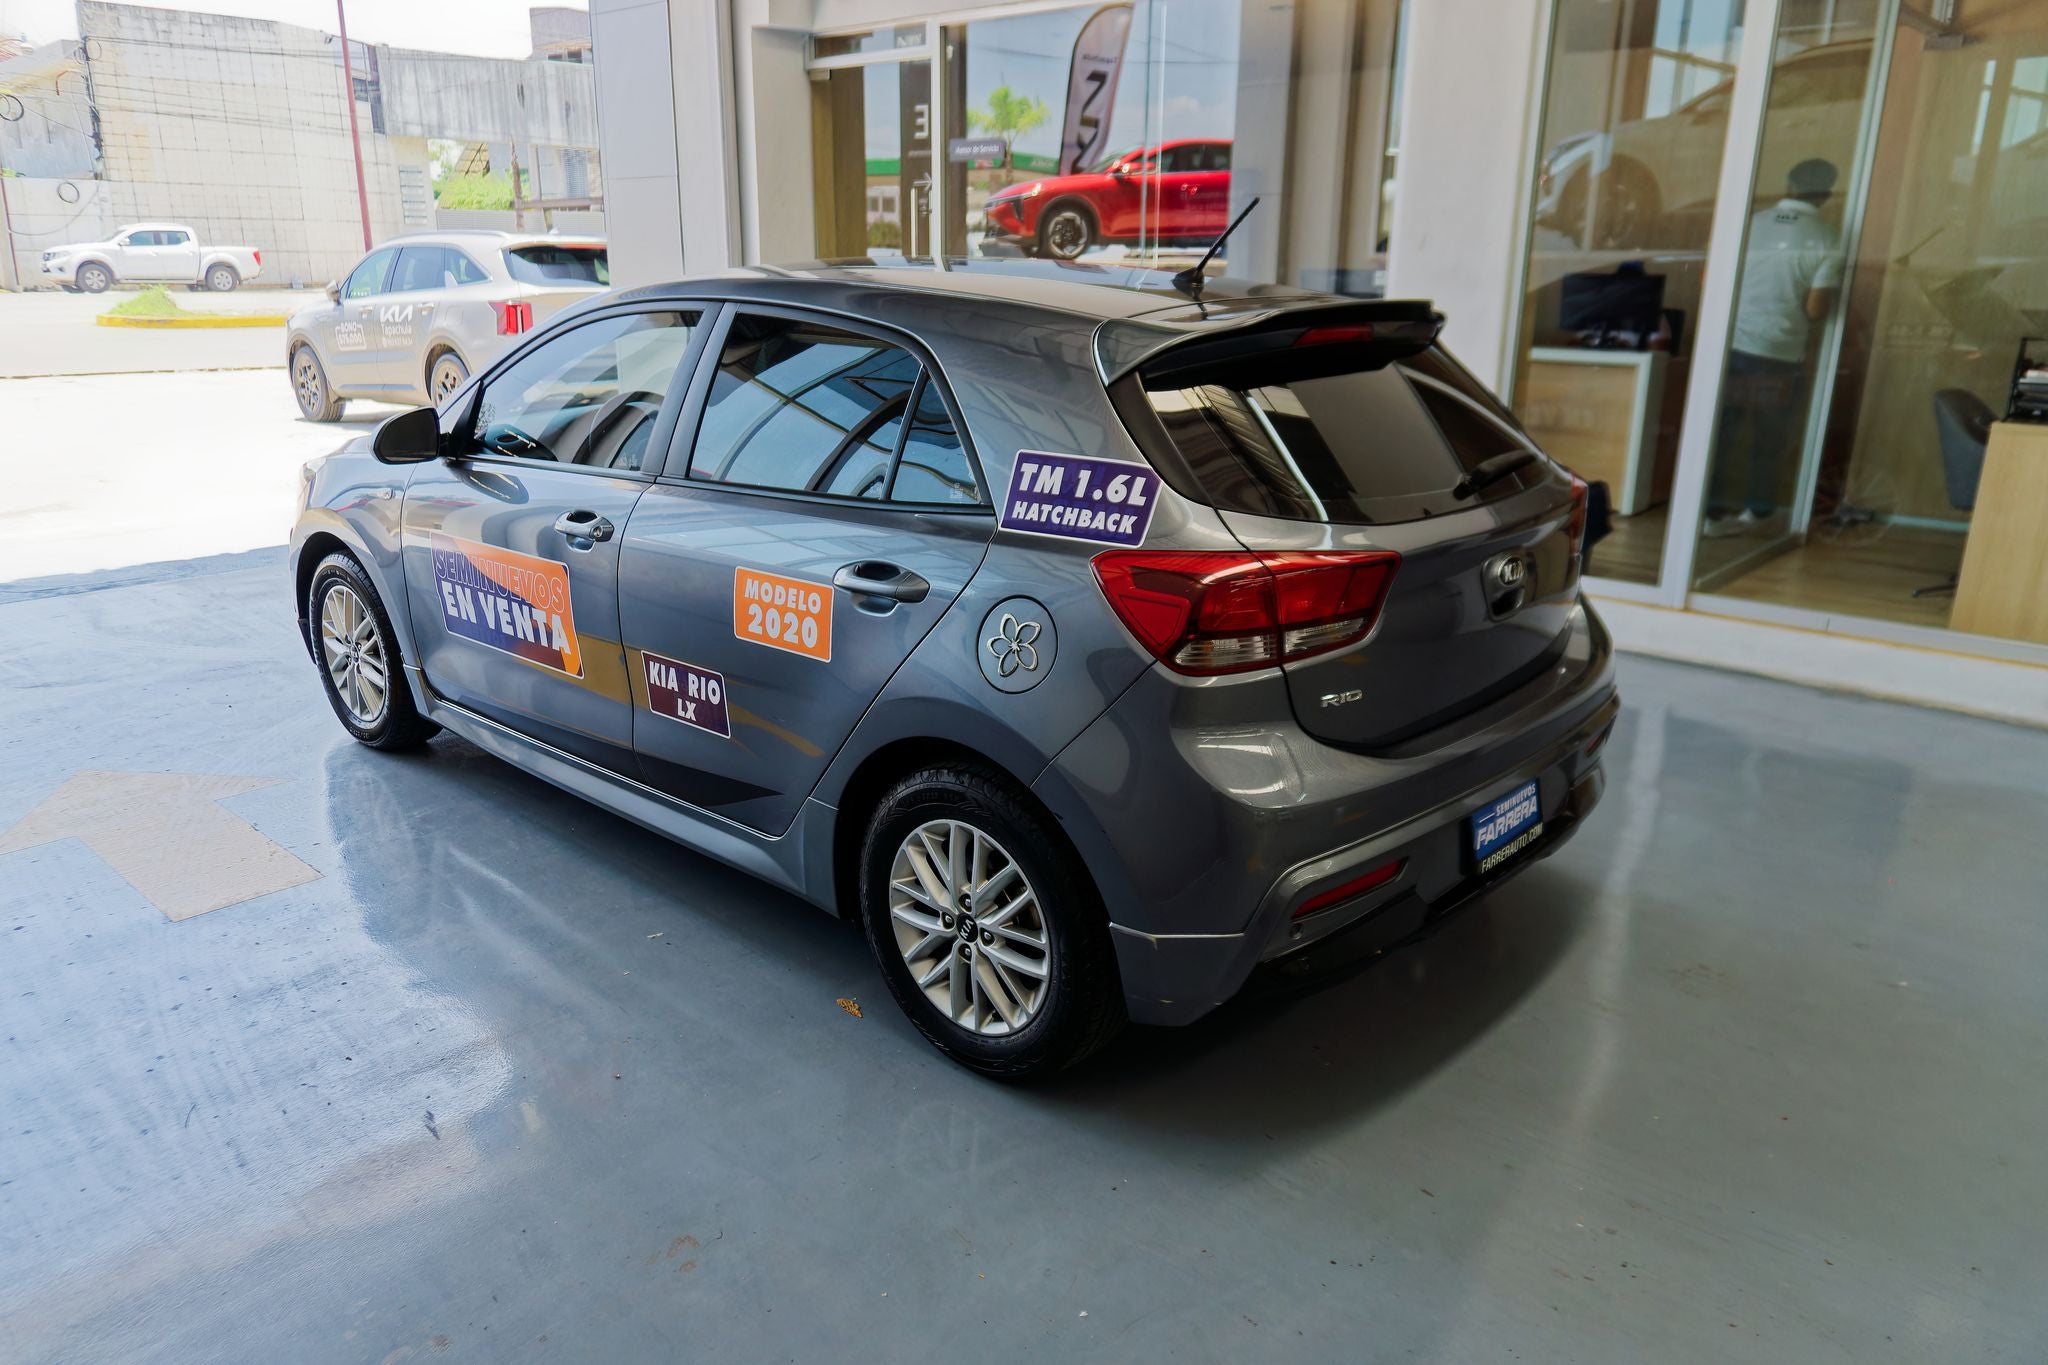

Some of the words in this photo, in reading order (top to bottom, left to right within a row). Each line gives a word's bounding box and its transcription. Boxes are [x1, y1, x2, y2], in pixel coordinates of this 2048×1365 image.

[380, 304, 413, 322] KIA
[381, 322, 412, 337] Tapachula
[1018, 462, 1065, 495] TM
[1074, 469, 1147, 506] 1.6L
[1011, 500, 1138, 534] HATCHBACK
[434, 549, 565, 614] SEMINUEVOS
[1504, 560, 1524, 583] KIA
[744, 578, 822, 615] MODELO
[441, 580, 478, 624] EN
[477, 591, 572, 655] VENTA
[748, 604, 818, 649] 2020
[649, 660, 680, 693] KIA
[688, 672, 722, 706] RIO
[1320, 689, 1363, 708] RIO
[677, 698, 697, 722] LX
[1495, 783, 1536, 817] SEMINUEVOS
[1475, 795, 1538, 851] FARRERA
[1481, 821, 1544, 874] FARRERAUTO.COM
[960, 919, 974, 939] KIA
